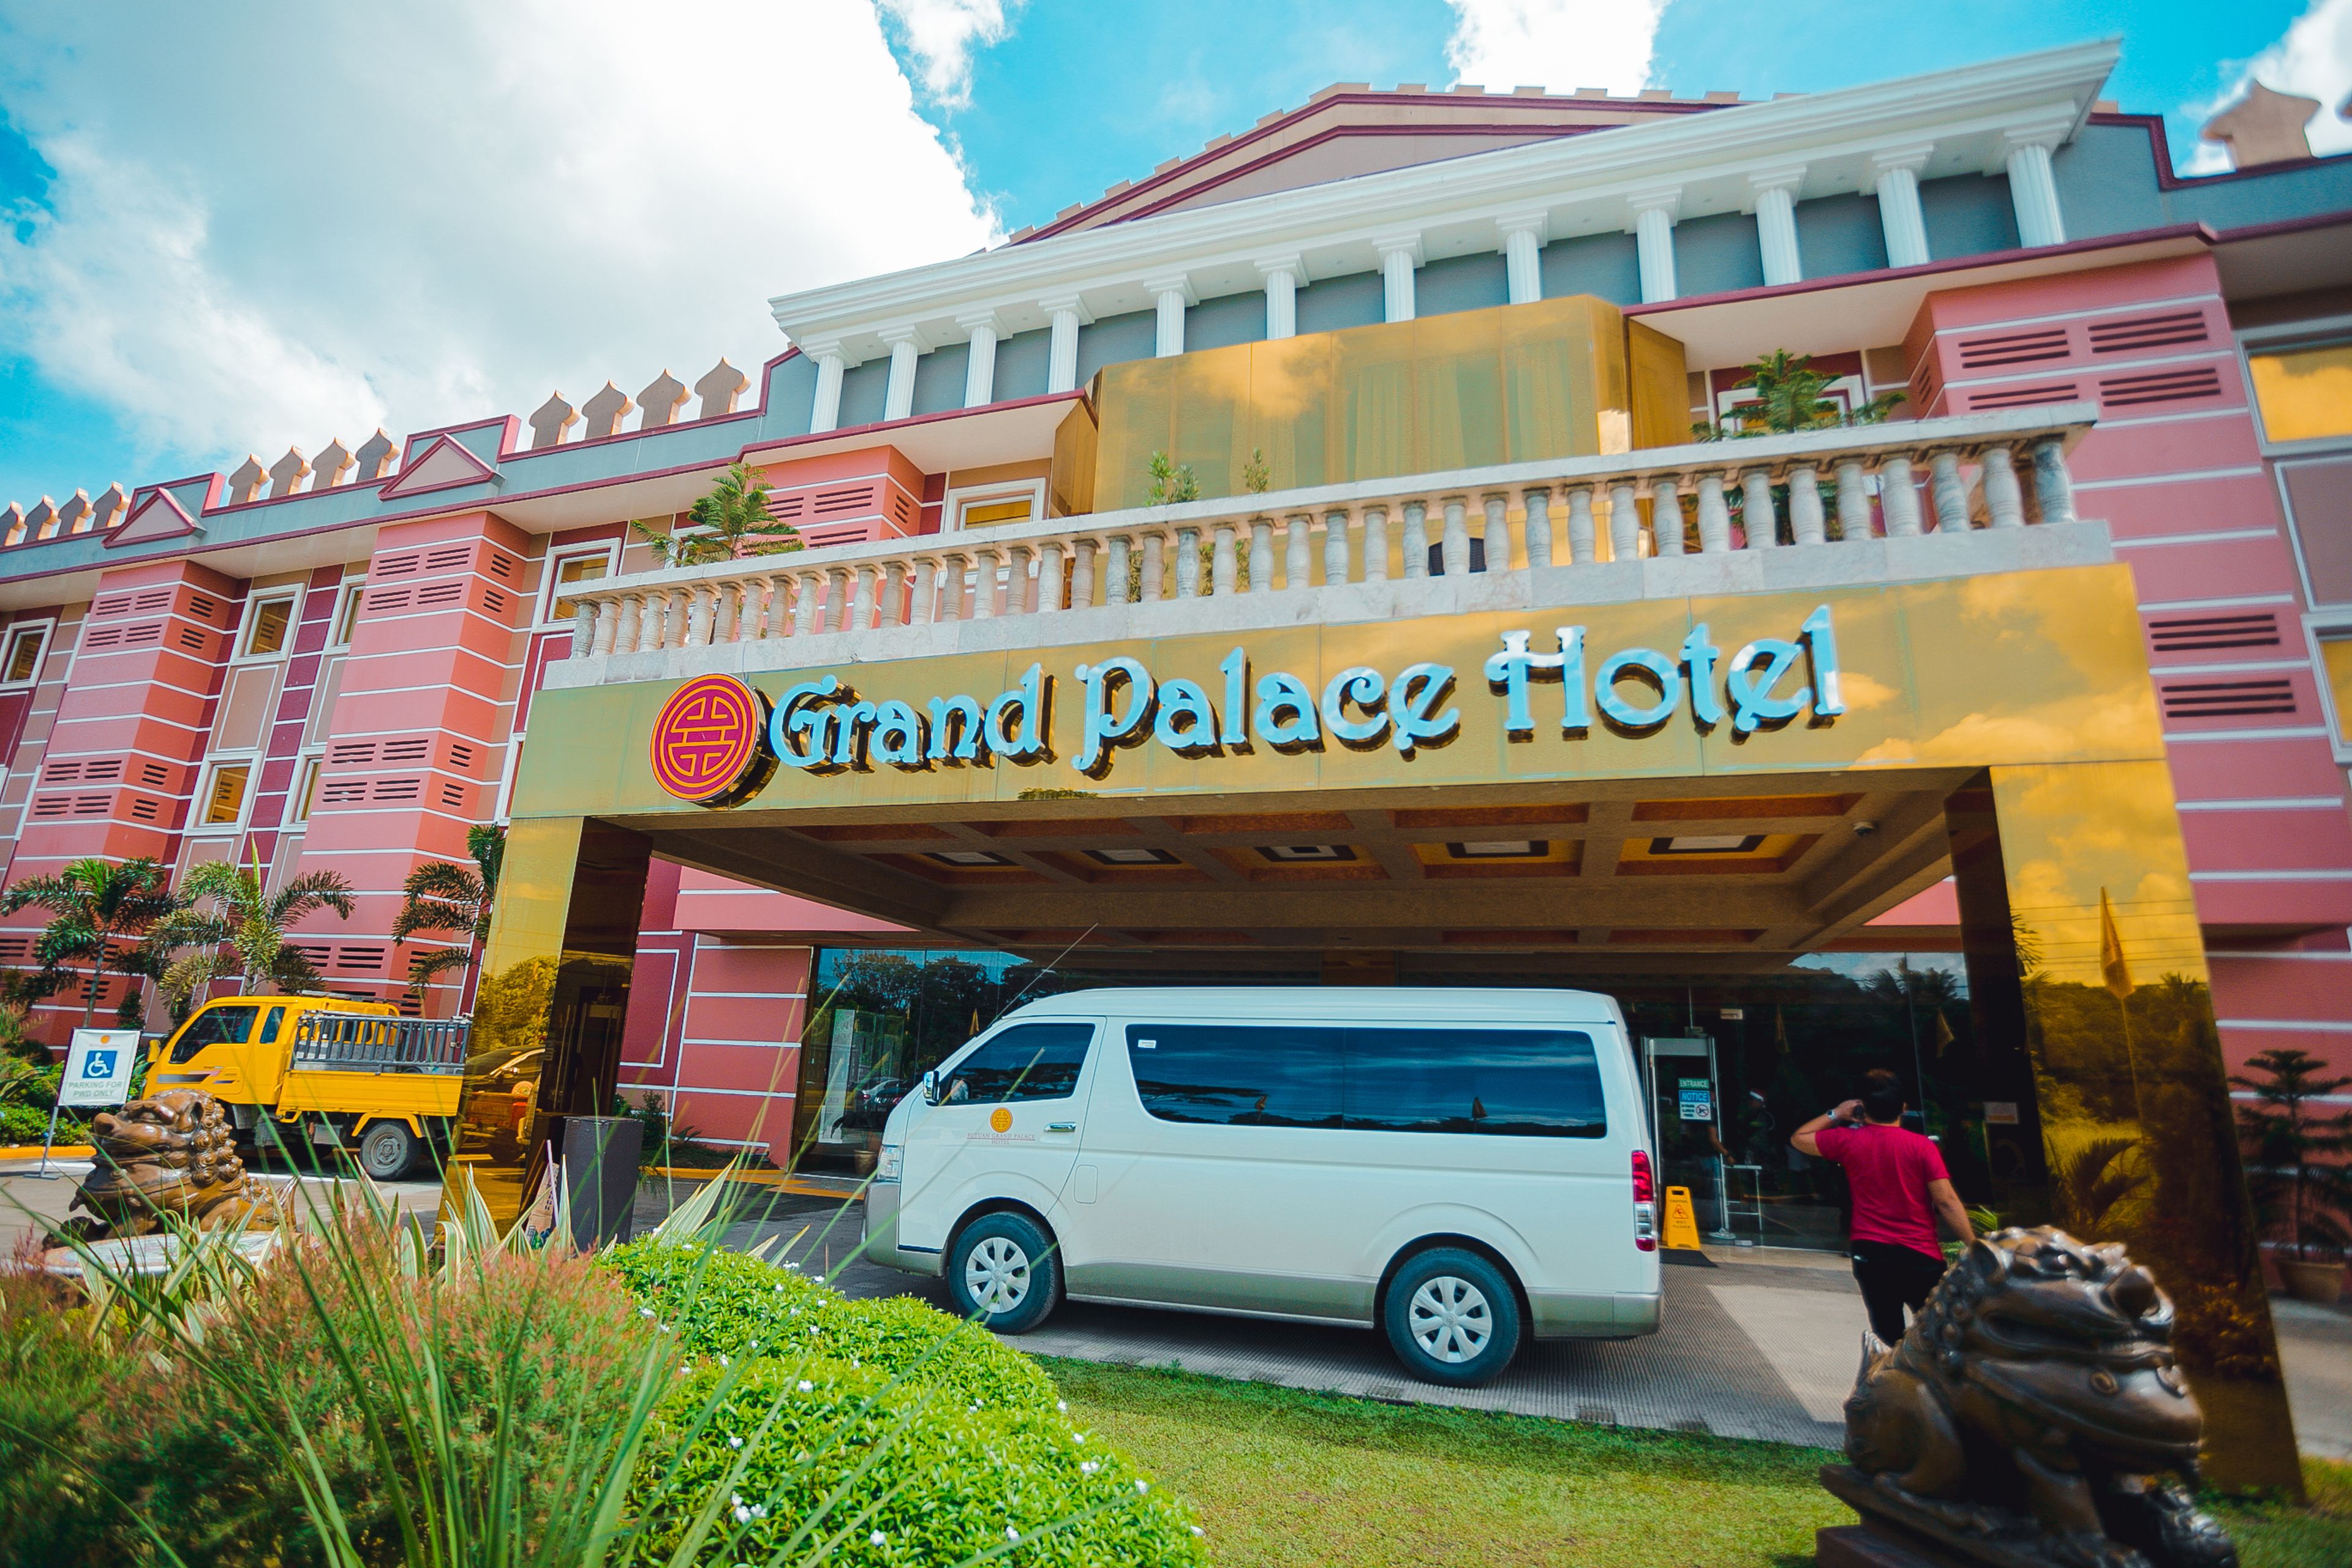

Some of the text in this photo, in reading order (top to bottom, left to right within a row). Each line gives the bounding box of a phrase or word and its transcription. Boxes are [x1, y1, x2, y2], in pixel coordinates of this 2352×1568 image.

[771, 603, 1845, 772] Grand Palace Hotel
[1681, 1092, 1708, 1101] NOTICE
